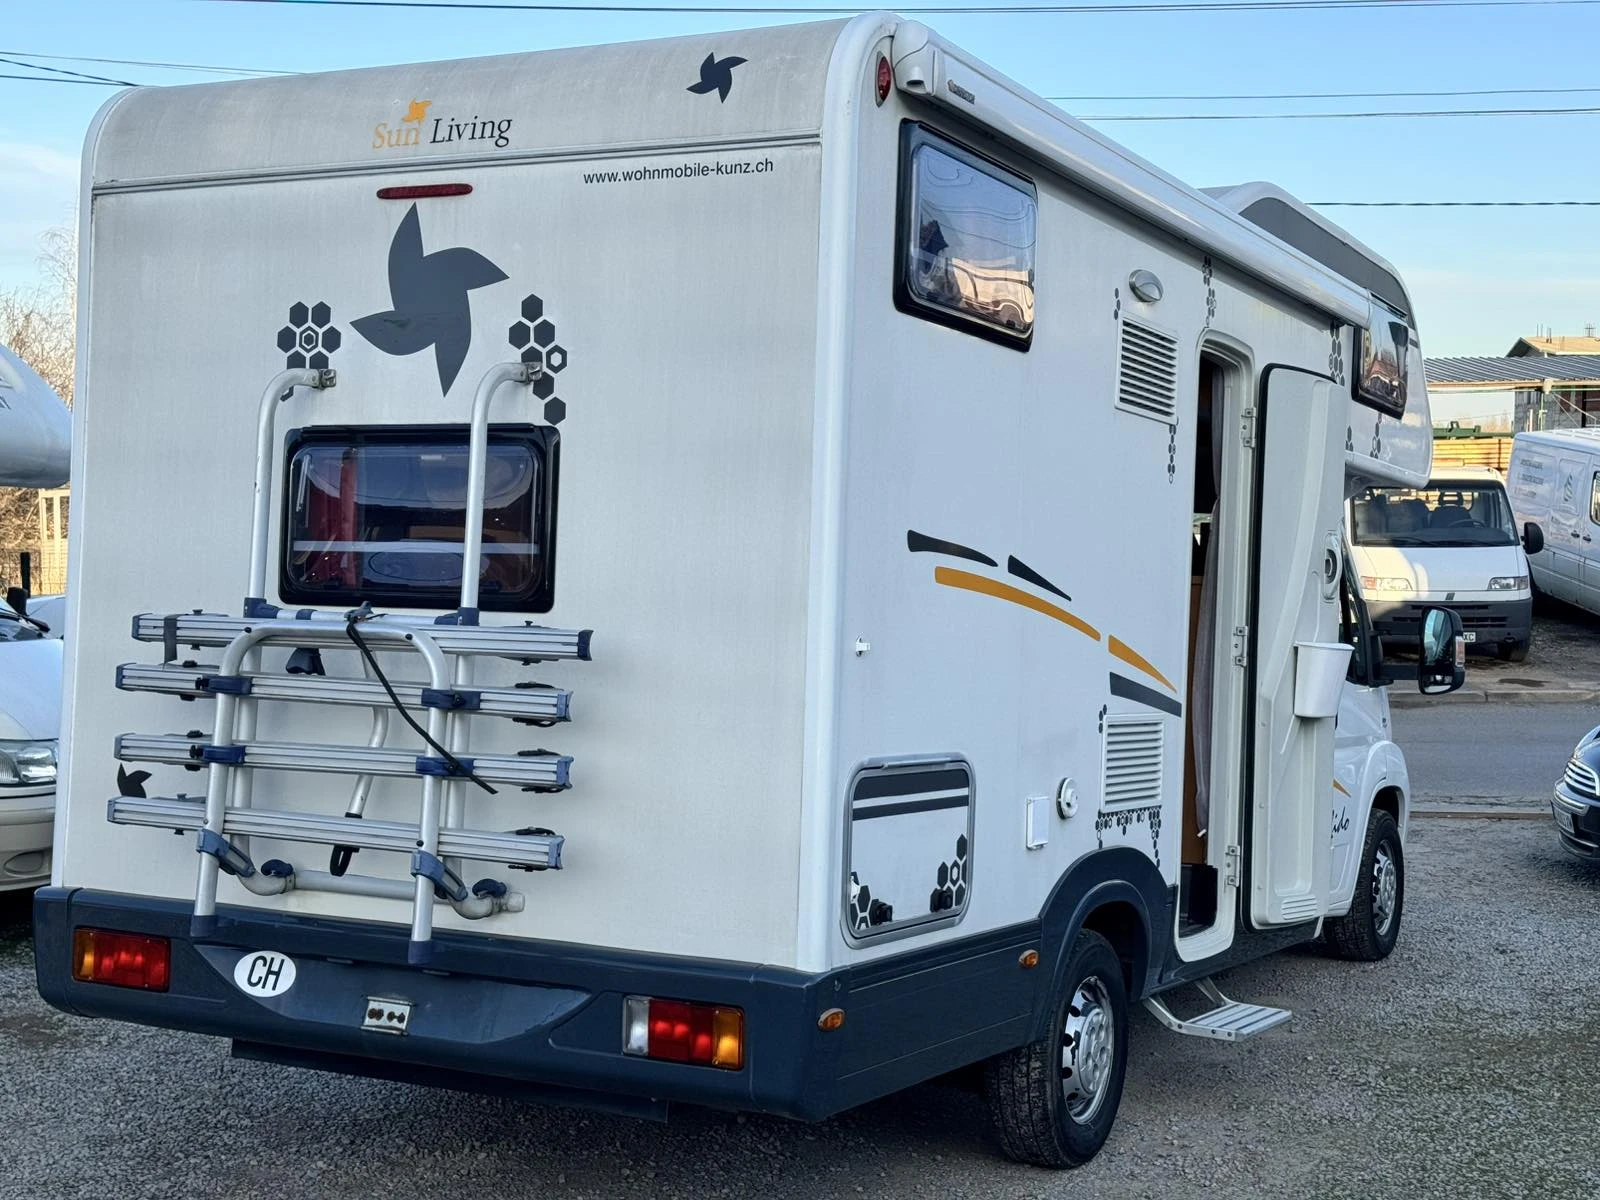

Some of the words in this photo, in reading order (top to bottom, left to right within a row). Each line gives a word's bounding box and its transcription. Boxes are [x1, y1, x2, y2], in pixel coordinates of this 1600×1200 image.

[372, 122, 420, 149] Sun
[429, 115, 513, 148] Living
[583, 158, 774, 184] www.wohnmobile-kunz.ch
[247, 955, 285, 991] CH
